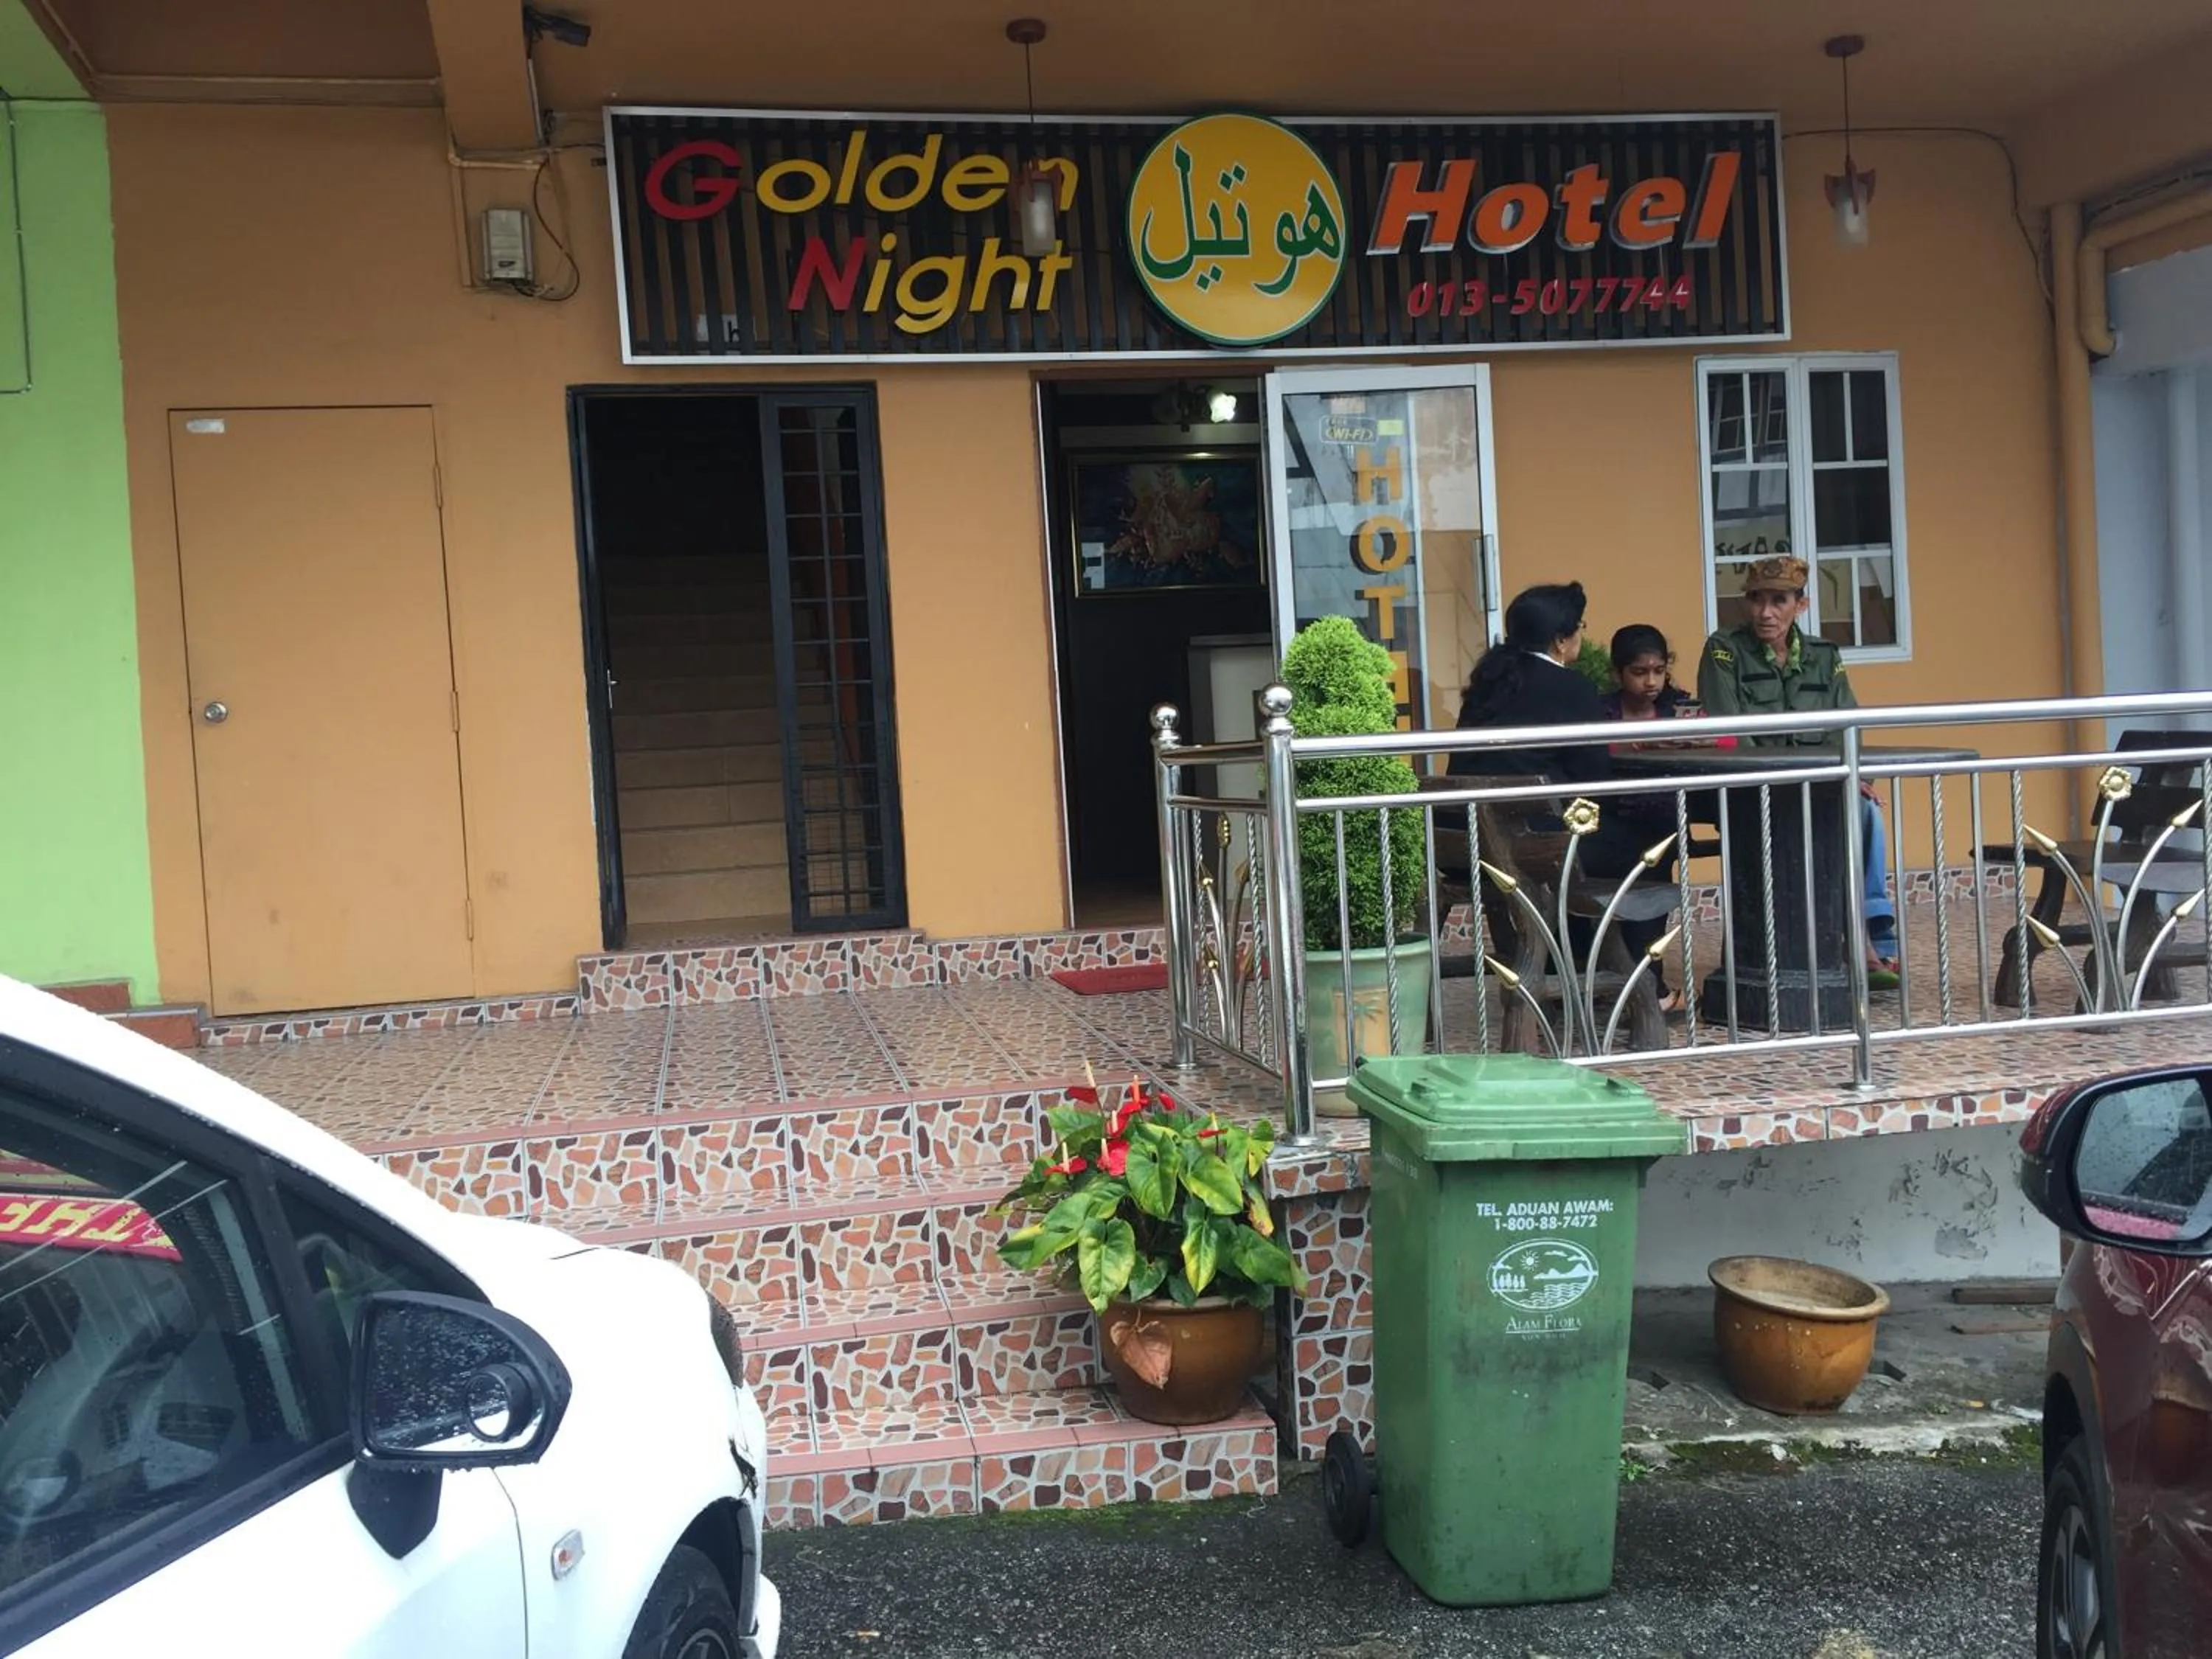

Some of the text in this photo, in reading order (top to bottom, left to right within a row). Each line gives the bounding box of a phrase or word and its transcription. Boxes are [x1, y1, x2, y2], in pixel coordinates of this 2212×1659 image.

[1366, 150, 1742, 255] Hotel
[787, 233, 1073, 334] Night
[1406, 274, 1693, 318] 013-5077744
[1476, 1199, 1614, 1217] TEL. ADUAN AWAM:
[1494, 1214, 1599, 1231] 1-800-88-7472
